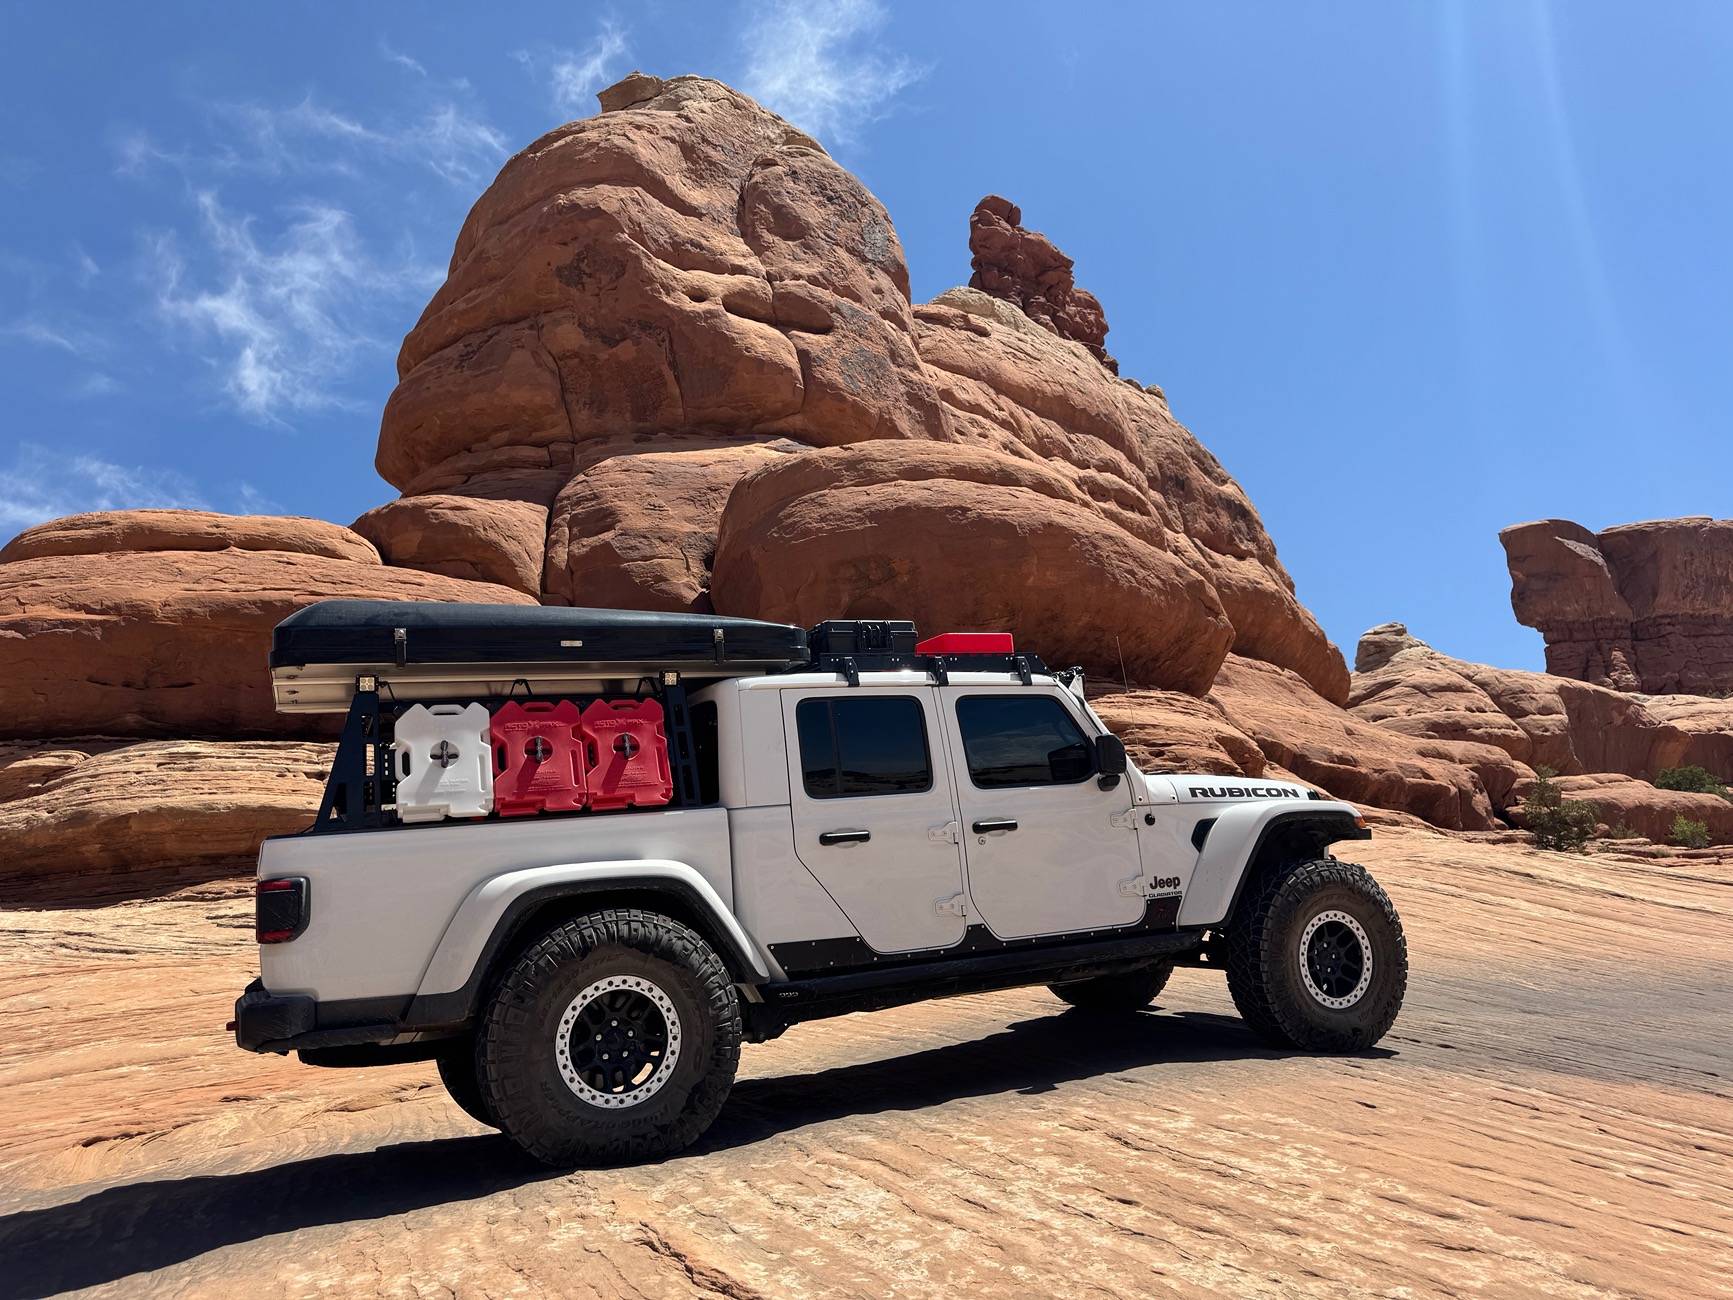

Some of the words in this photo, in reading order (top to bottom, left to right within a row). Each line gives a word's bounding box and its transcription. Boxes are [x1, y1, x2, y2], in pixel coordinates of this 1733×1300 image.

[1188, 787, 1300, 798] RUBICON
[1149, 876, 1181, 890] Jeep
[1148, 890, 1183, 898] GLADIATOR
